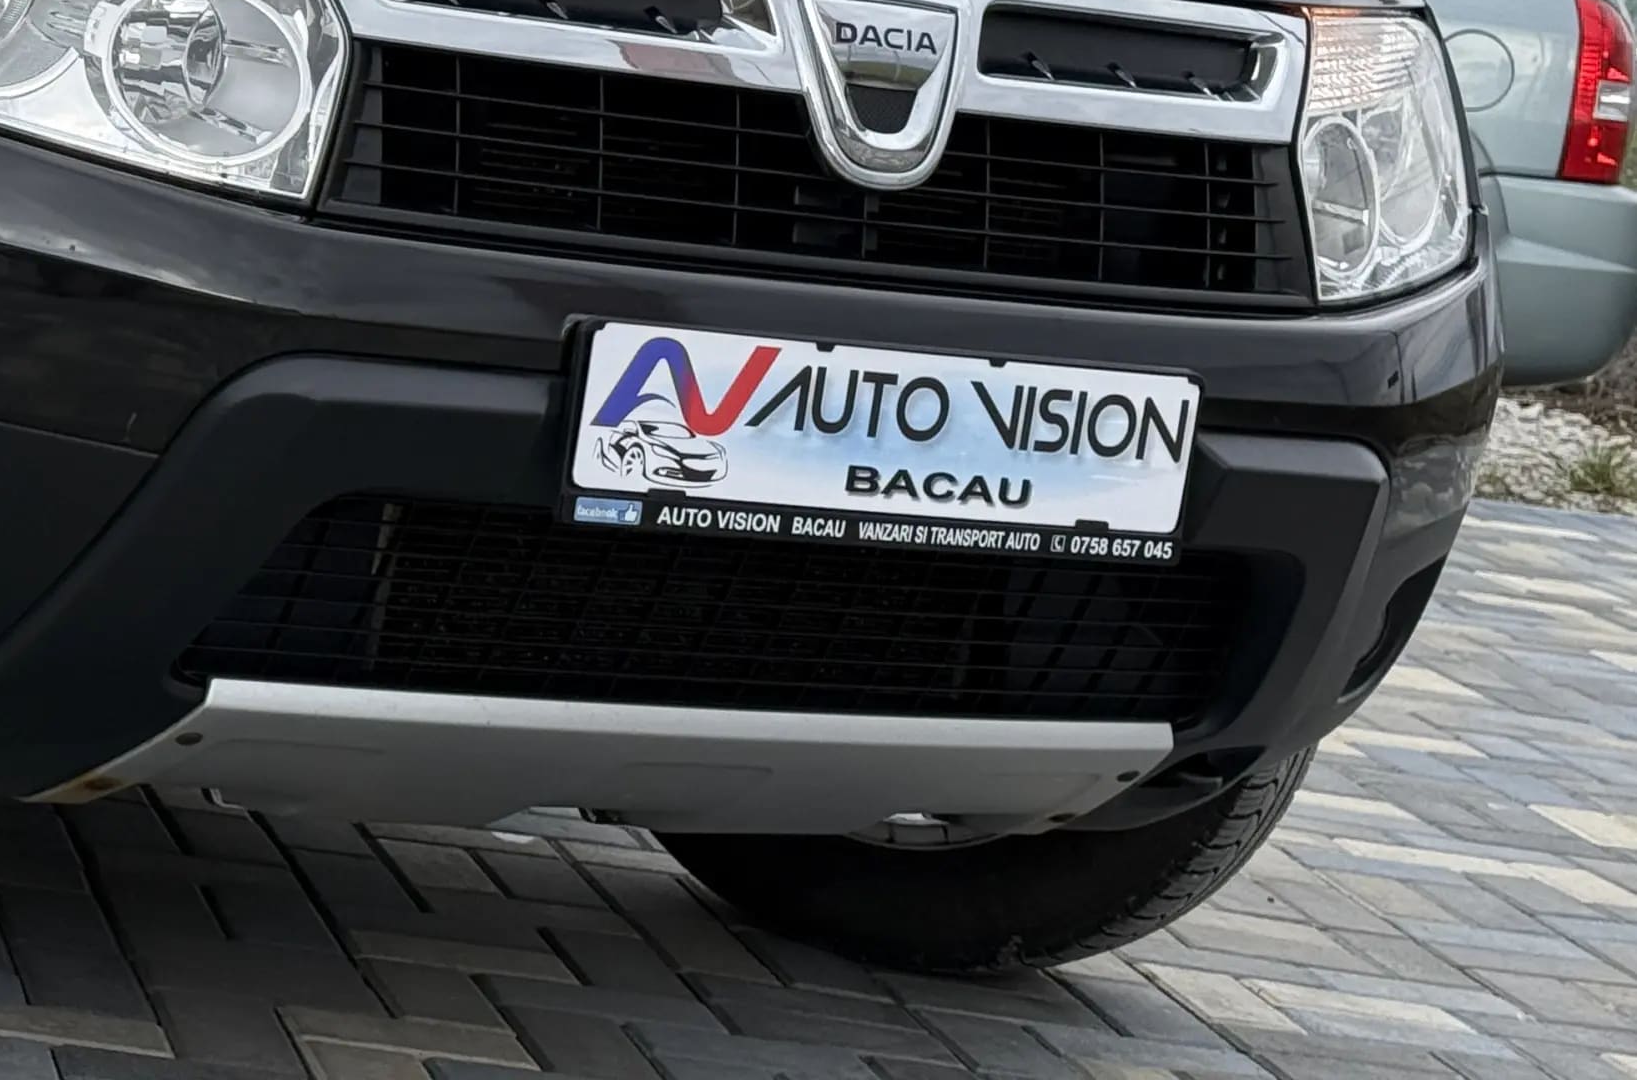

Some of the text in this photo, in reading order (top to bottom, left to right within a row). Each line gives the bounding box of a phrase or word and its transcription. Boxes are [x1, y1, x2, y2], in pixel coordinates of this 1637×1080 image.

[835, 21, 937, 55] DACIA
[744, 365, 1190, 464] AUTO VISION
[845, 464, 1033, 507] BACAU
[657, 506, 1173, 560] AUTO VISION BACAU VANZARI SI TRANSPORT AUTO 0758 657 045
